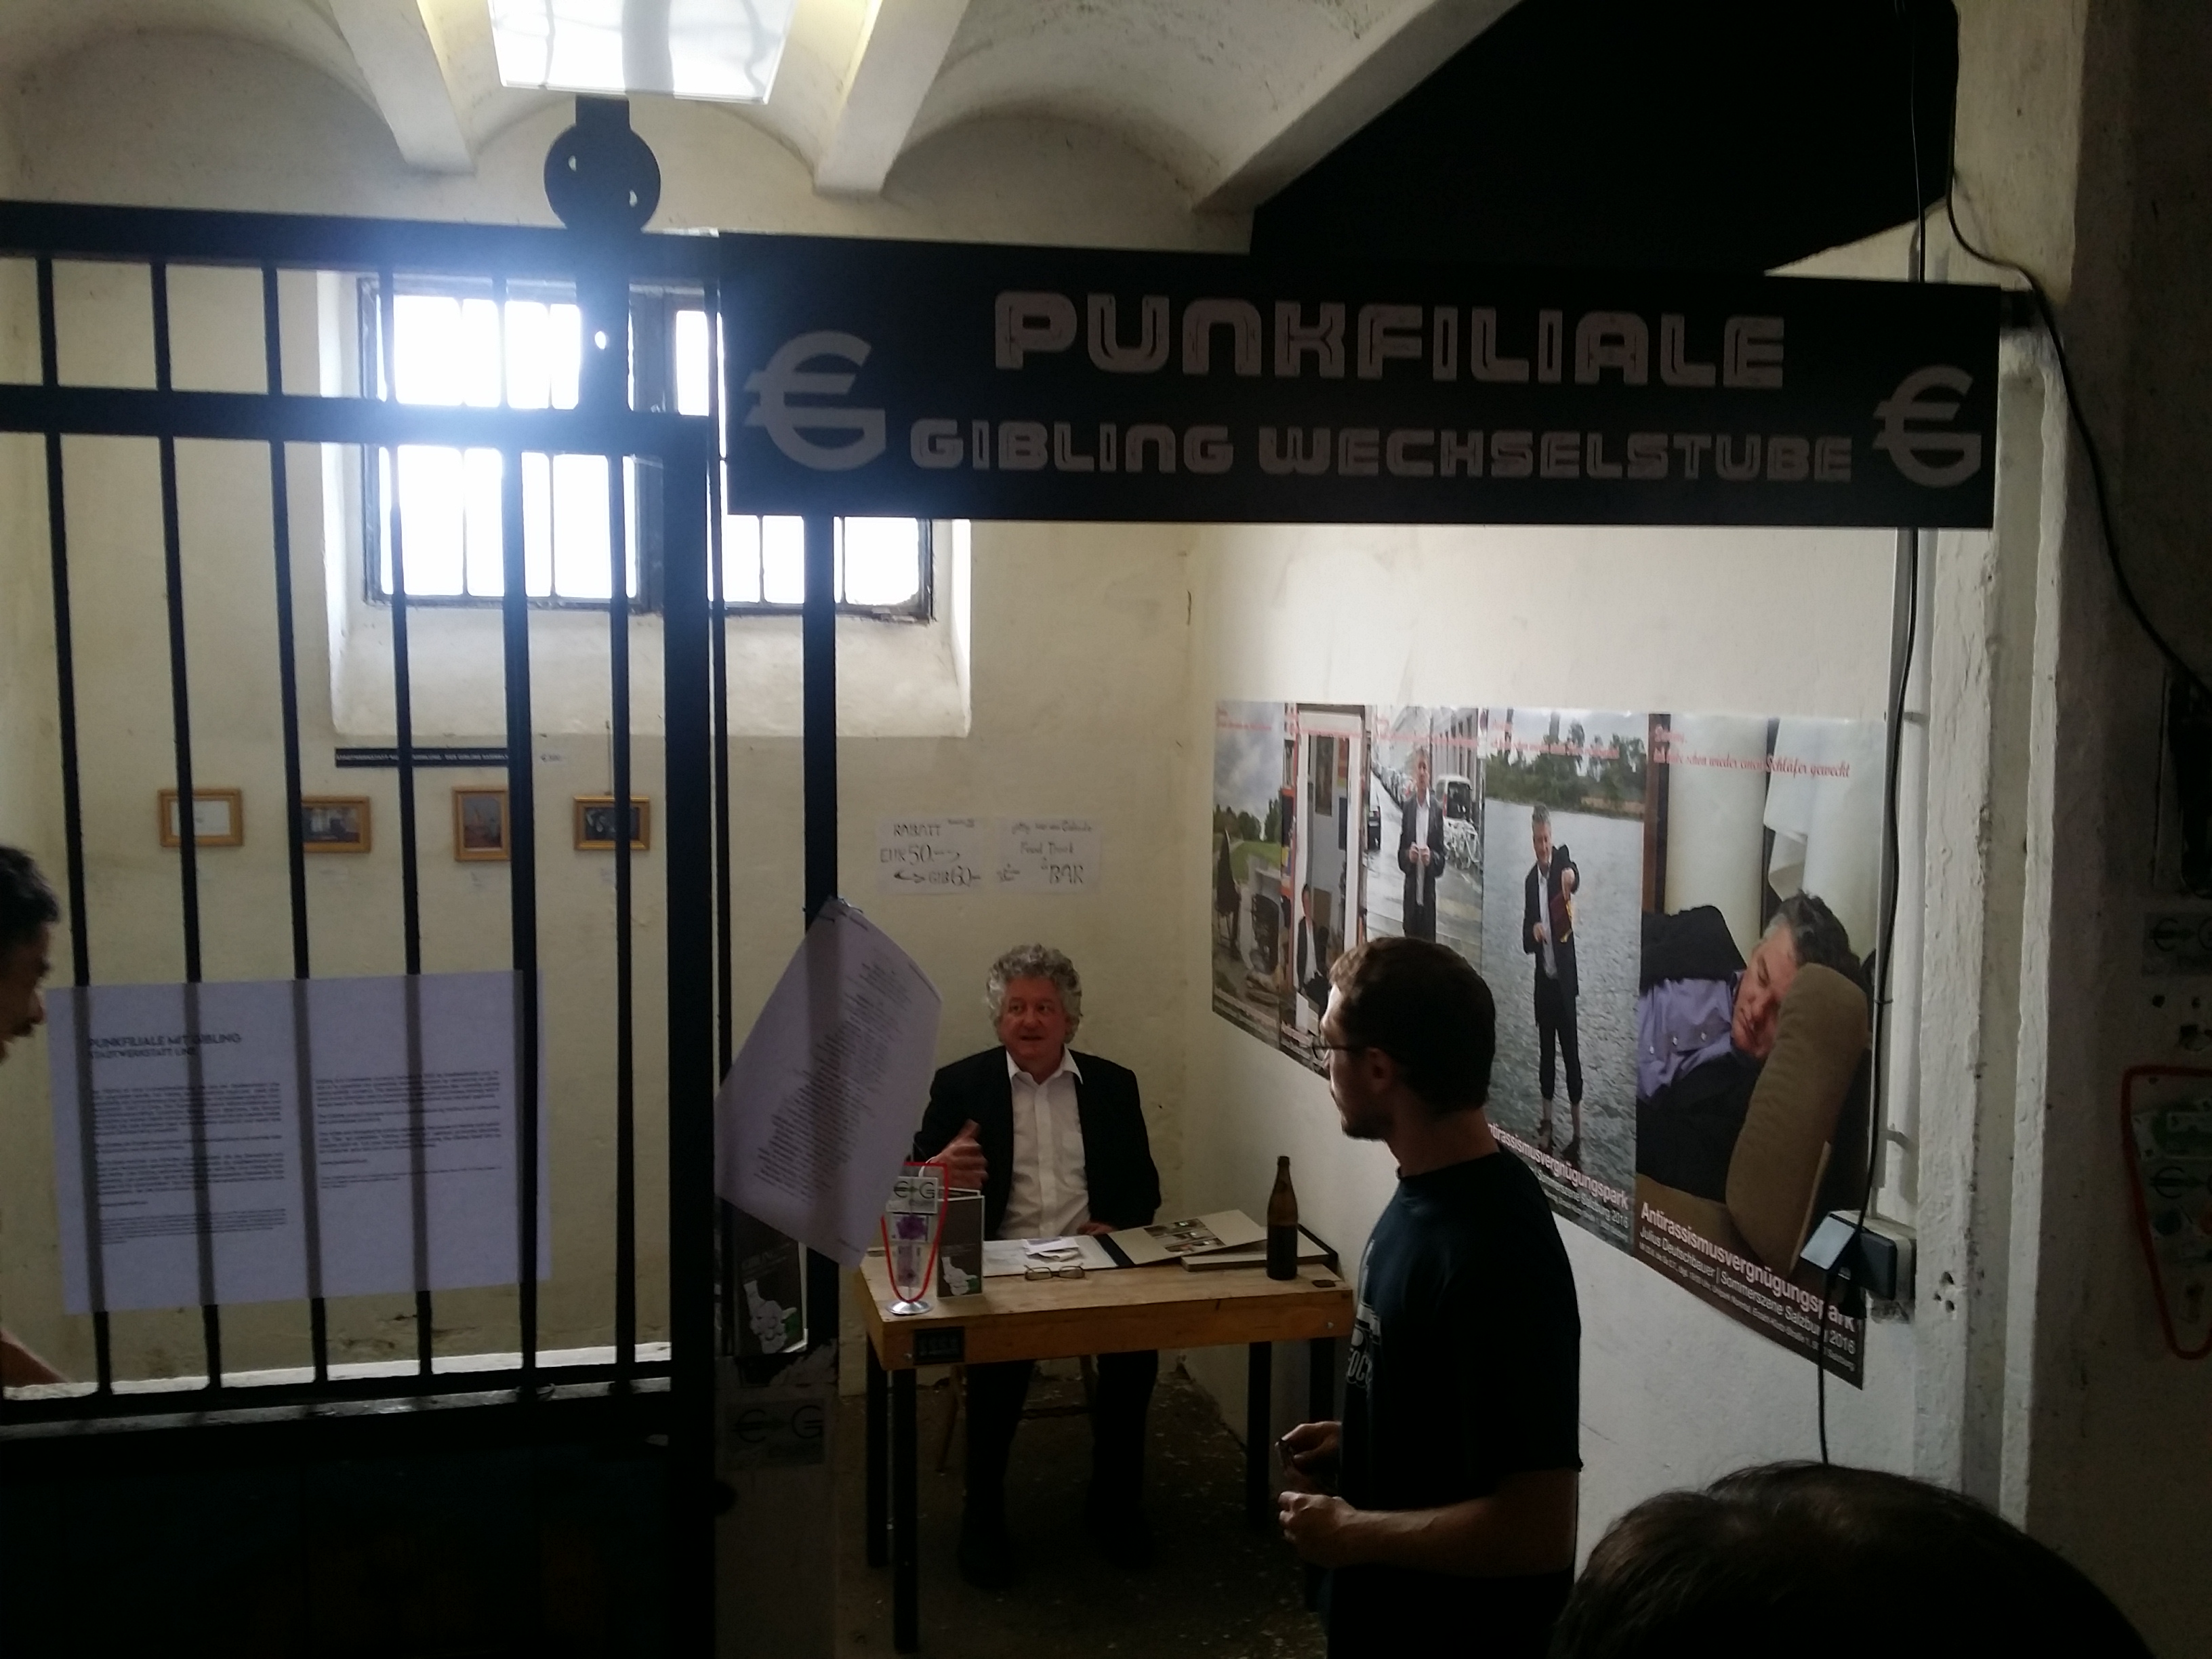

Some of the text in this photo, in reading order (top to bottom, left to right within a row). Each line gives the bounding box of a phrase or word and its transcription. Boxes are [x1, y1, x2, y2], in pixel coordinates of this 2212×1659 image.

[994, 290, 1785, 390] PUNKFILIALE
[910, 417, 1853, 482] GIBLING WECHSELSTUBE
[1488, 1122, 1629, 1210] ntirassismusvergnügungspark
[1639, 1226, 1662, 1248] Julius
[1662, 1237, 1716, 1277] Deutschbauer
[1721, 1271, 1784, 1317] Sommerszene
[1829, 1329, 1856, 1355] 2016
